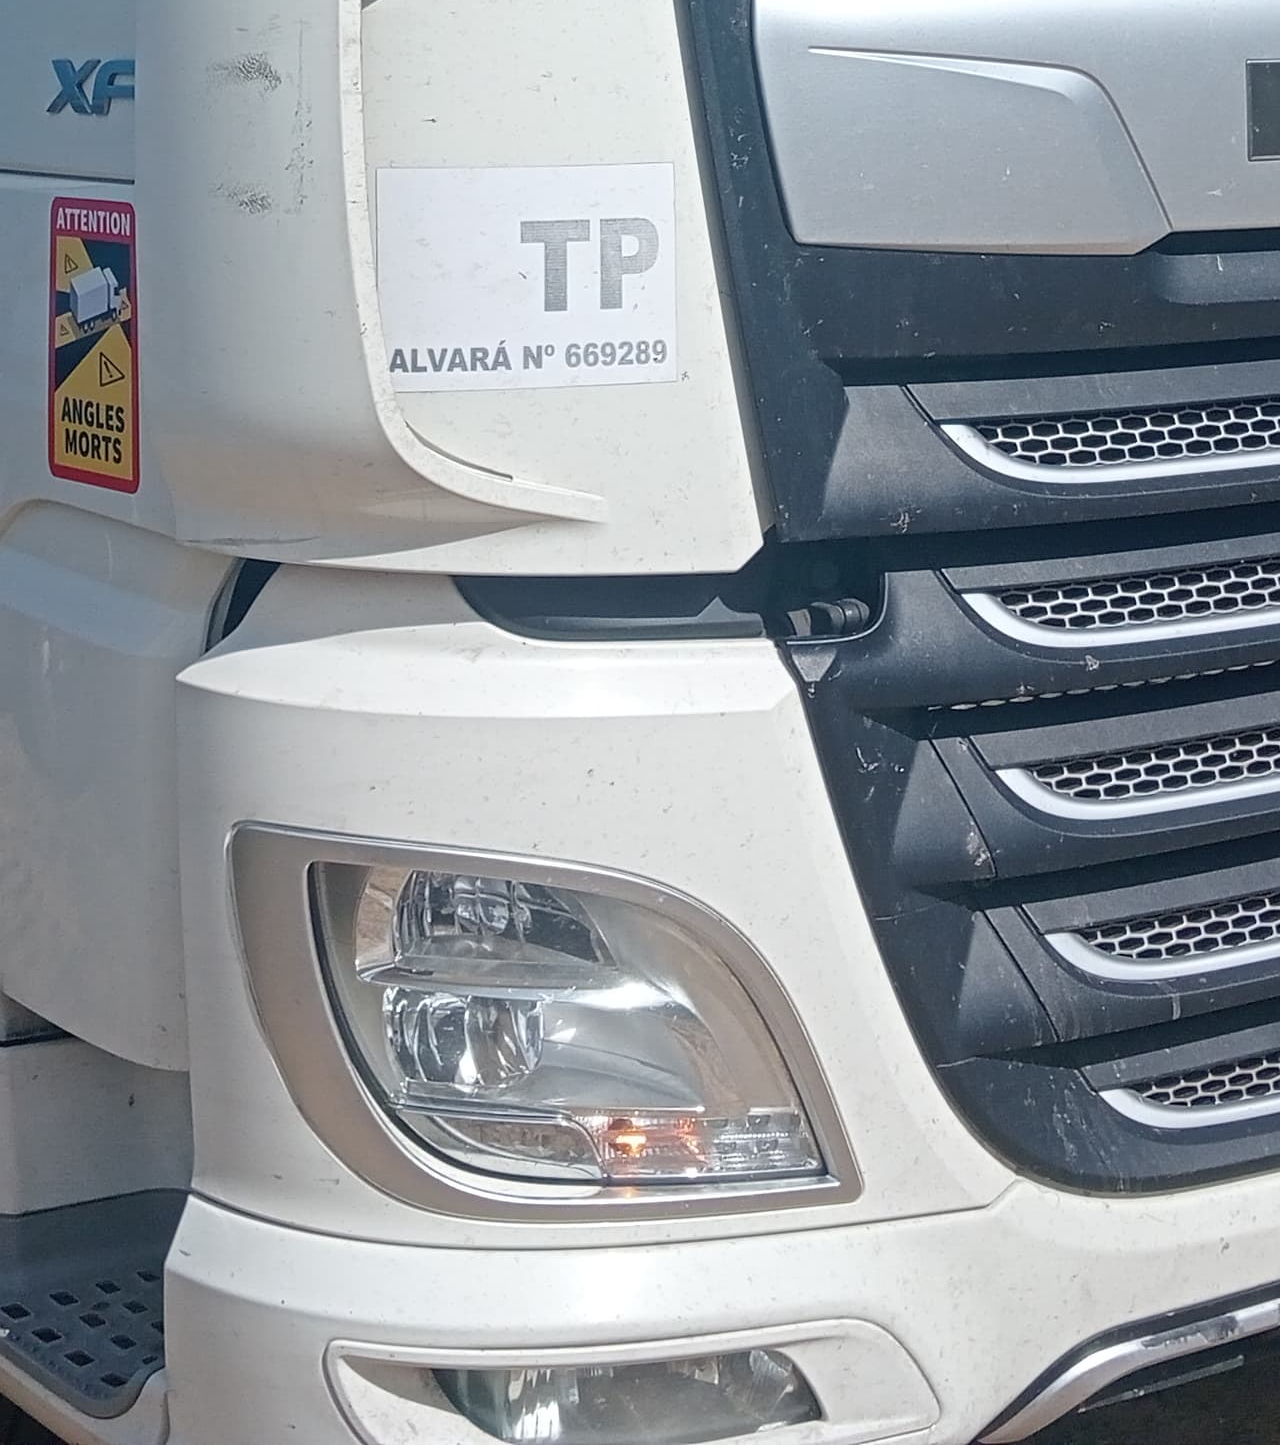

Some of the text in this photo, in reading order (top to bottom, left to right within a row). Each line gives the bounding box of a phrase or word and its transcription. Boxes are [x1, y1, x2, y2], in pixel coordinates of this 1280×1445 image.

[46, 58, 135, 116] XF
[56, 207, 131, 237] ATTENTION
[519, 217, 659, 312] TP
[389, 340, 512, 374] ALVARÁ
[564, 339, 668, 368] 669289
[61, 396, 125, 434] ANGLES
[64, 427, 122, 465] MORTS
